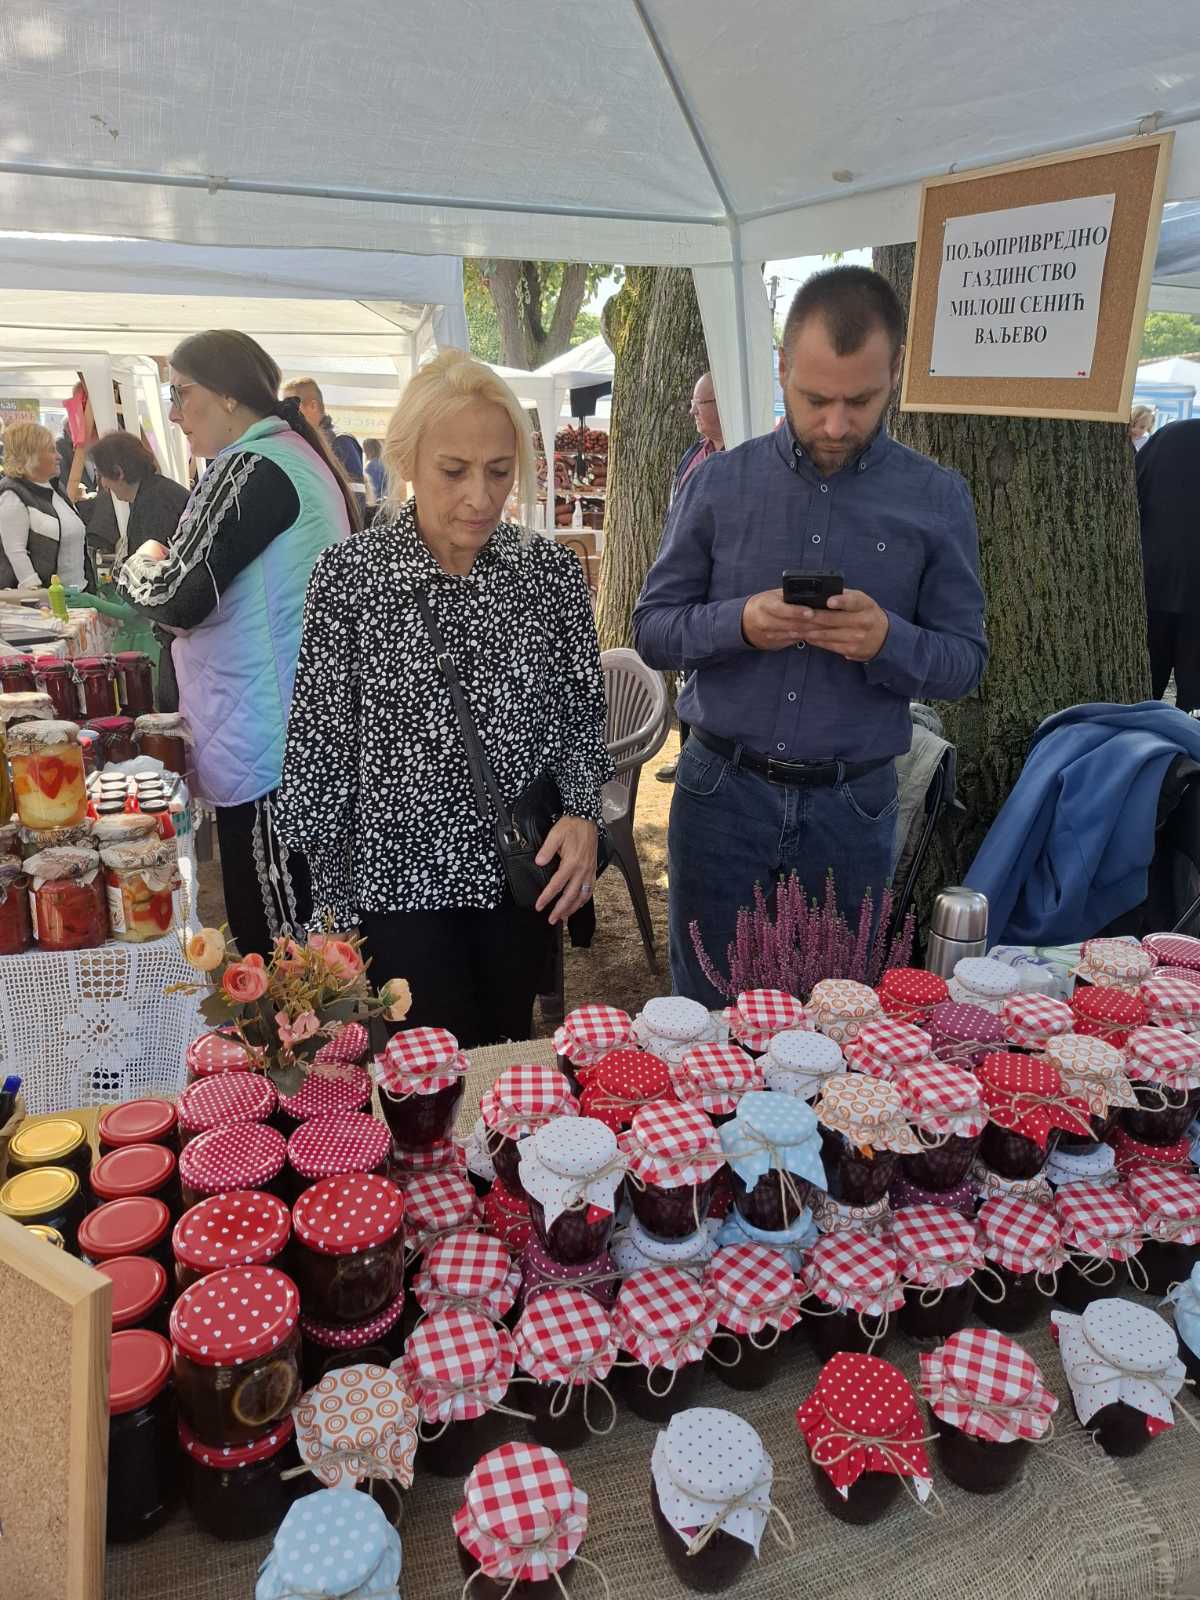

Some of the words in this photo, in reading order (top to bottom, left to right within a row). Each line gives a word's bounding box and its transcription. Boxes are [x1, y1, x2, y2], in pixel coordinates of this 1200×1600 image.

[946, 226, 1107, 261] ПОЉОПРИВРЕДНО
[962, 262, 1077, 288] ГАЗДИНСТВО
[950, 297, 1016, 316] МИЛОШ
[1020, 293, 1085, 314] СЕНИЋ
[975, 325, 1047, 344] ВАЉЕВО
